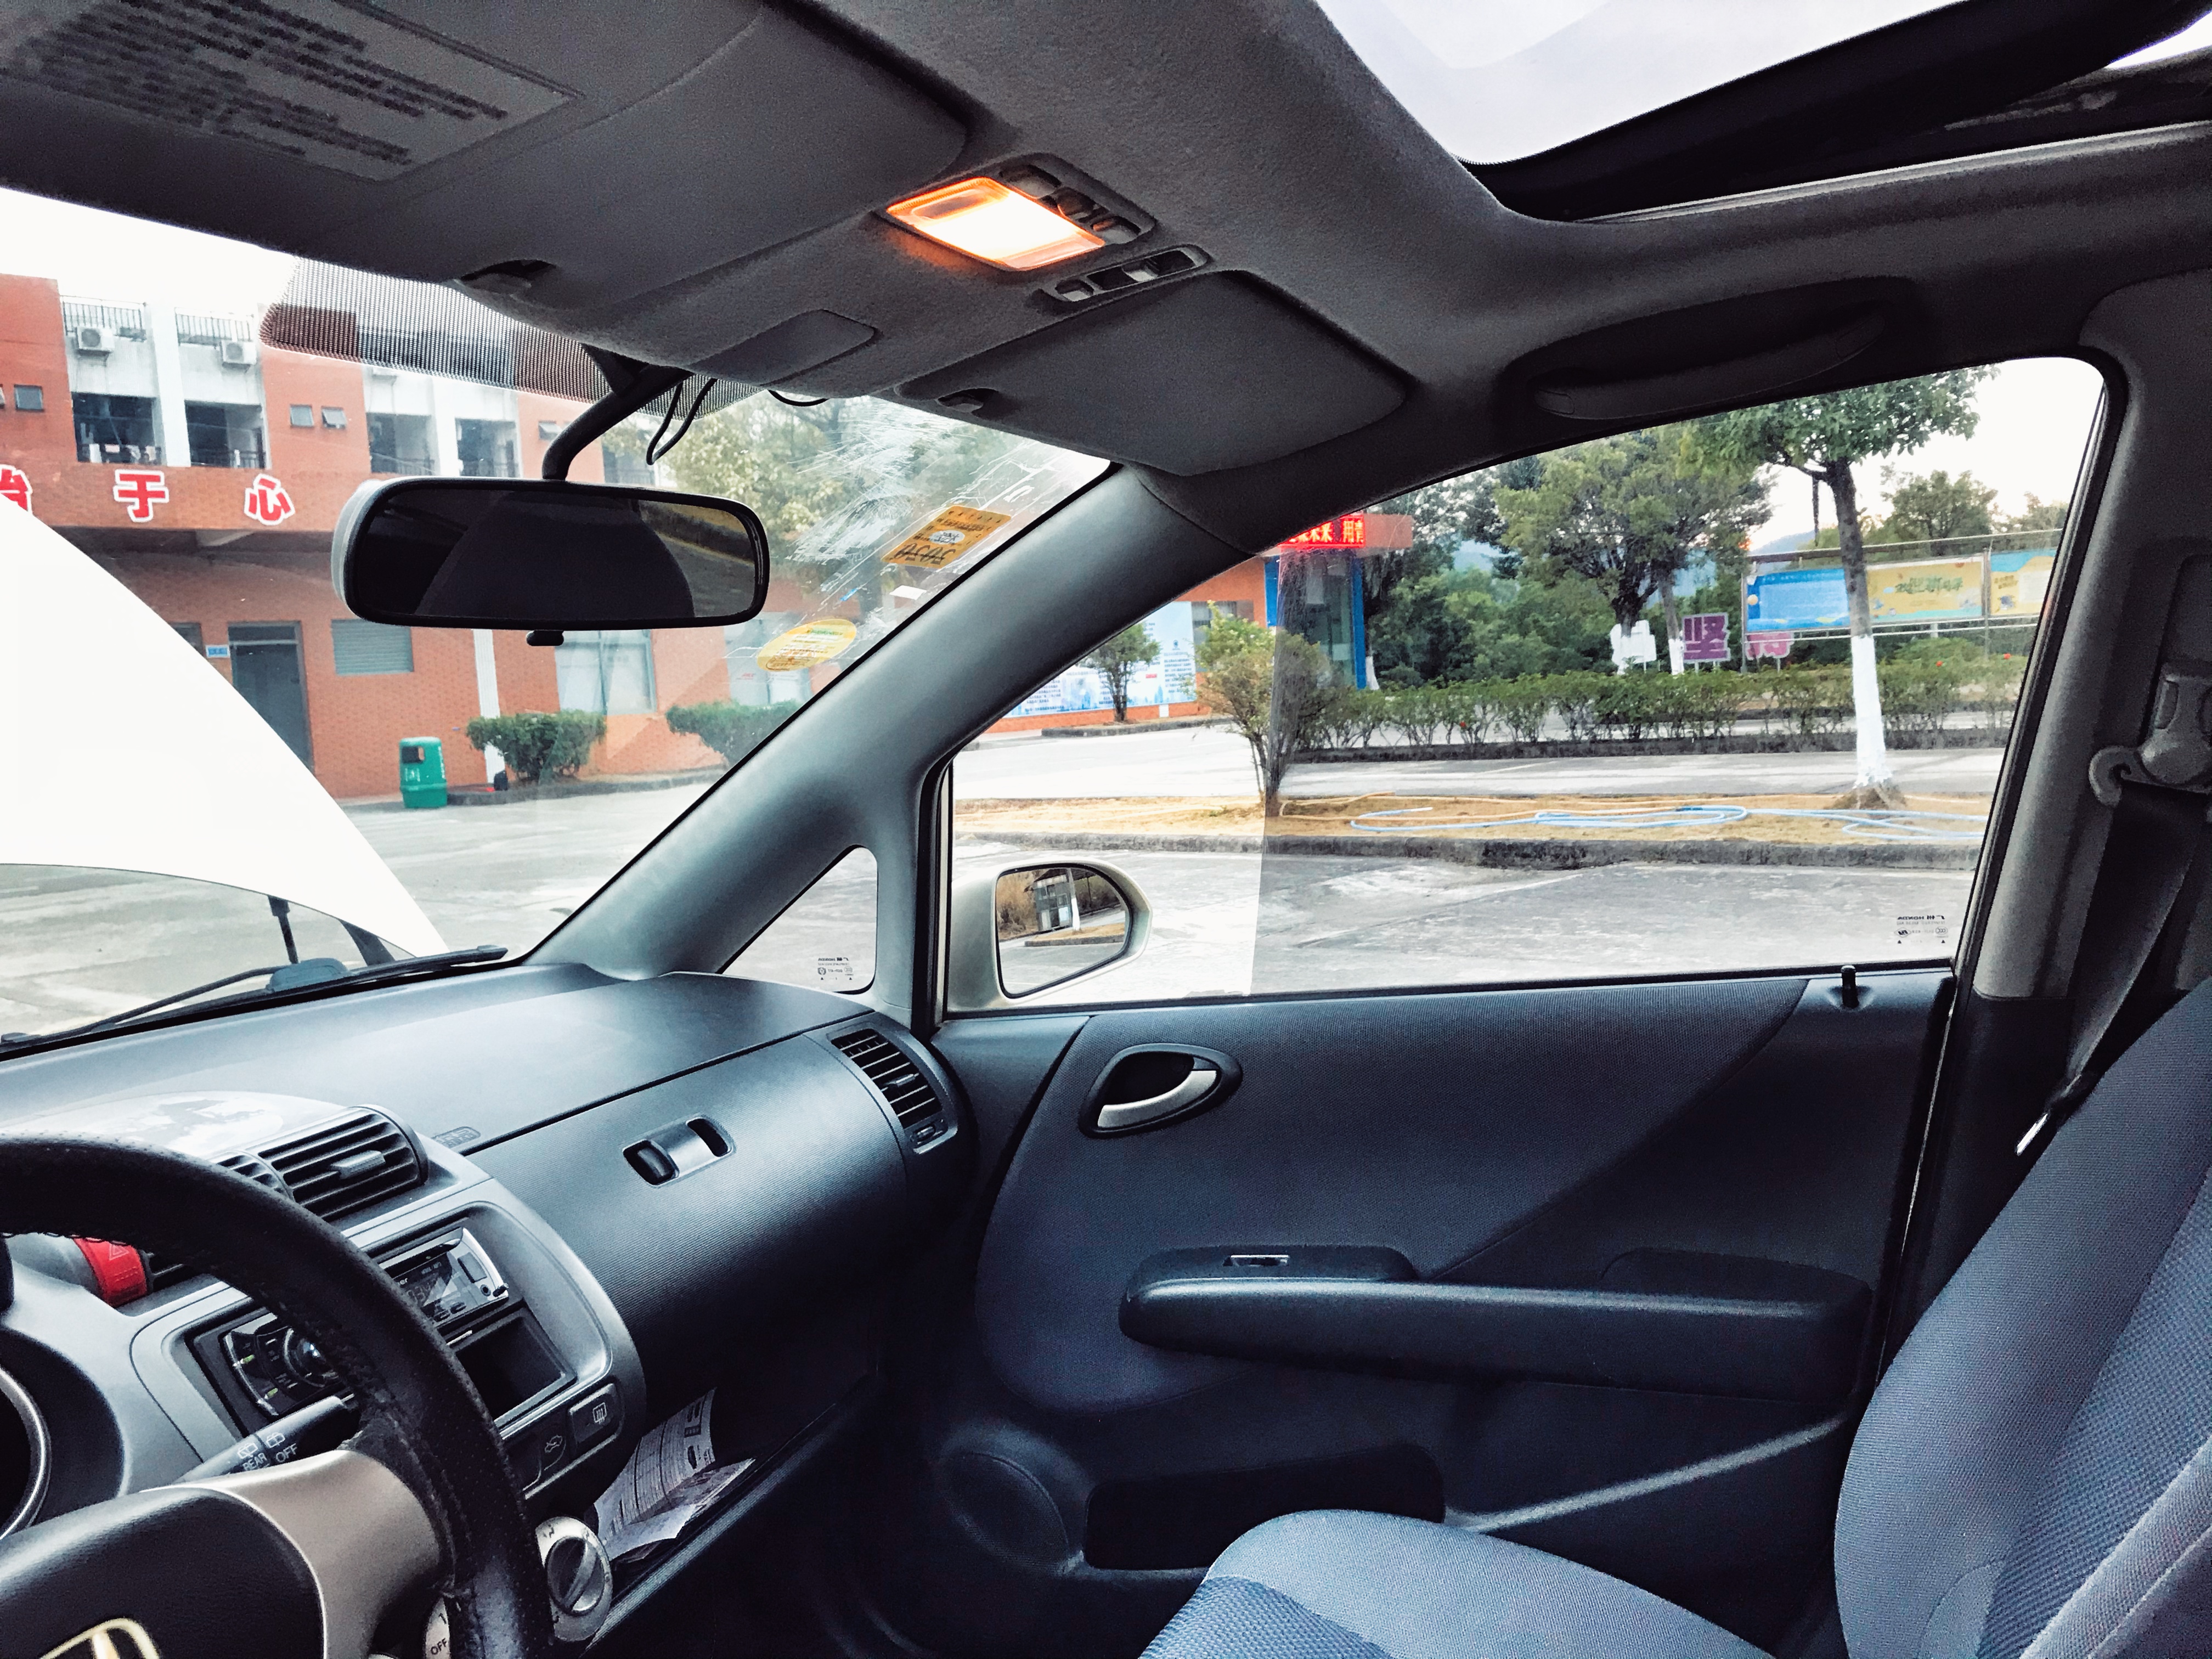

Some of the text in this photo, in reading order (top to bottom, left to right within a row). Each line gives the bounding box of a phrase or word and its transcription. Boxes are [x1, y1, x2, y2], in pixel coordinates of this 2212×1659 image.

[242, 1452, 268, 1471] REAR
[275, 1442, 298, 1463] OFF
[430, 1638, 447, 1655] OFF
